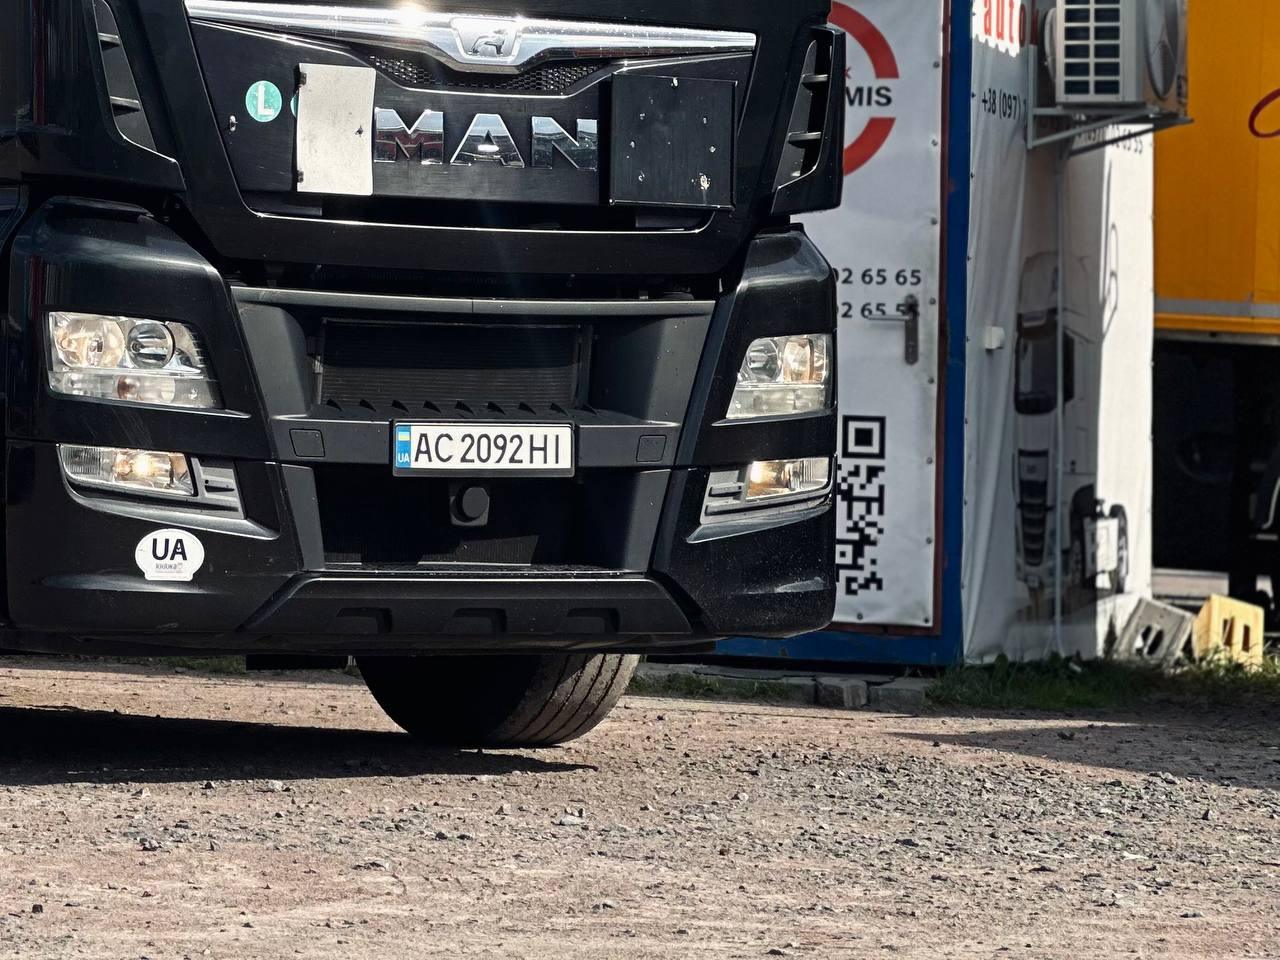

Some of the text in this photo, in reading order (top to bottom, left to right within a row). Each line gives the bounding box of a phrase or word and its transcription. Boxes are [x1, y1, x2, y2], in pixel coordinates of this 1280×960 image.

[257, 81, 275, 117] L
[373, 107, 598, 171] MAN
[861, 268, 888, 286] 65
[895, 269, 923, 288] 65
[397, 453, 410, 463] UA
[152, 538, 188, 561] UA
